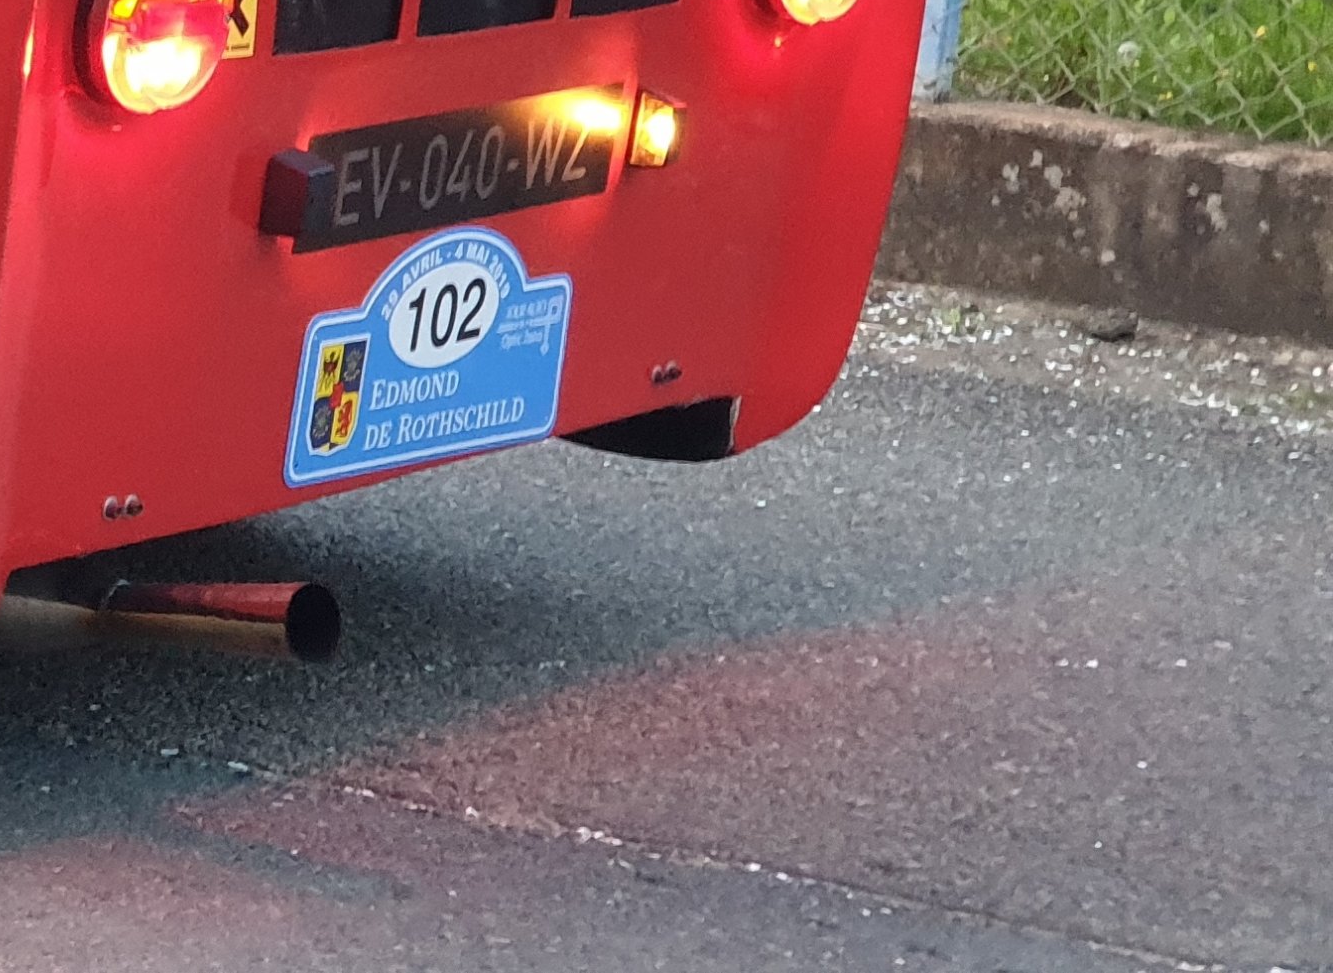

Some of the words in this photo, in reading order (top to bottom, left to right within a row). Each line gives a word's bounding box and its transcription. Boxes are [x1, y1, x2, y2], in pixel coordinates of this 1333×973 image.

[335, 114, 590, 227] EV-040-WZ
[402, 248, 444, 291] AVRIL
[454, 242, 464, 259] 4
[466, 242, 490, 266] MAI
[408, 278, 487, 352] 102
[370, 370, 460, 412] EDMOND
[363, 422, 393, 452] DE
[396, 396, 525, 444] ROTHSCHILD
